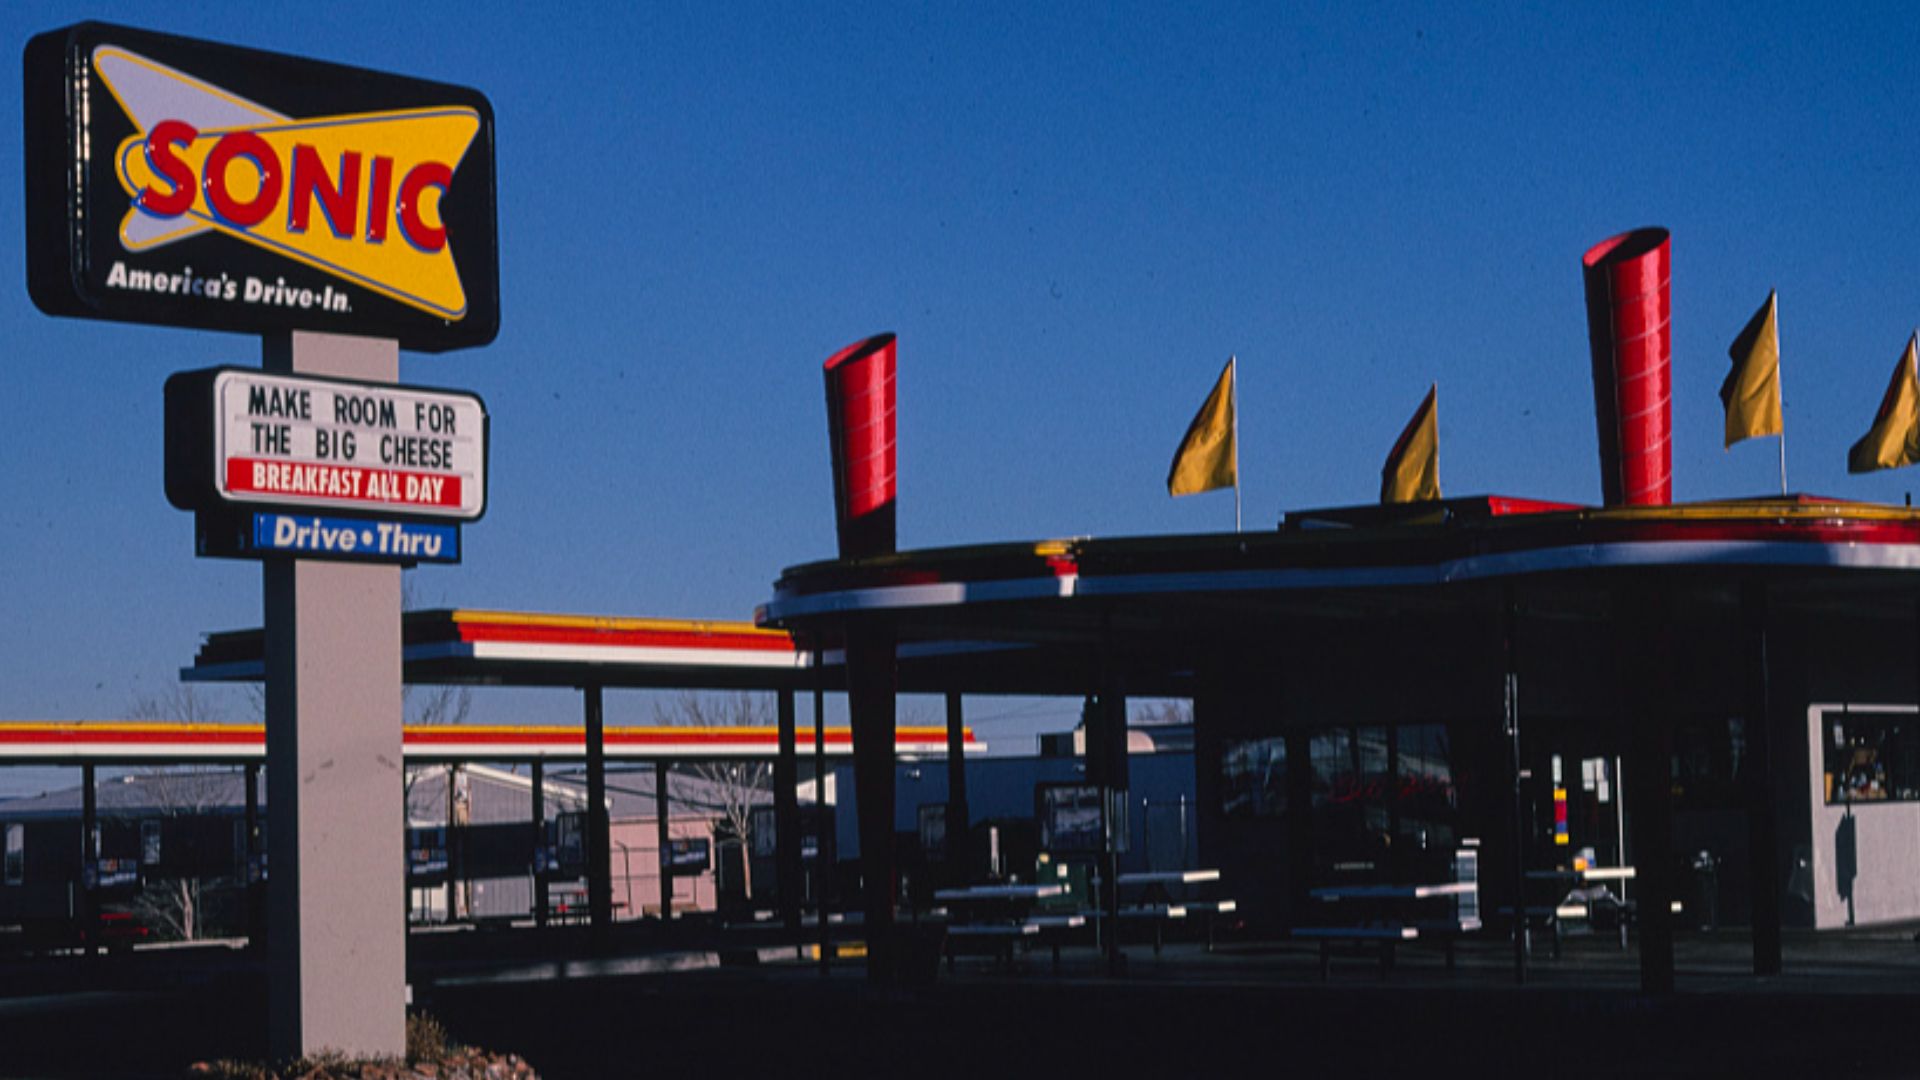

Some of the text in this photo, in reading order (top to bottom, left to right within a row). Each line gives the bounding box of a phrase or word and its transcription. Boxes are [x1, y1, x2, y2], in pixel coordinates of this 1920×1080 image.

[136, 119, 453, 253] SONIC
[106, 261, 237, 300] America's
[248, 385, 456, 435] MAKE ROOM FOR
[251, 423, 452, 469] THE BIG CHEESE
[252, 461, 444, 503] BREAKFAST ALL DAY
